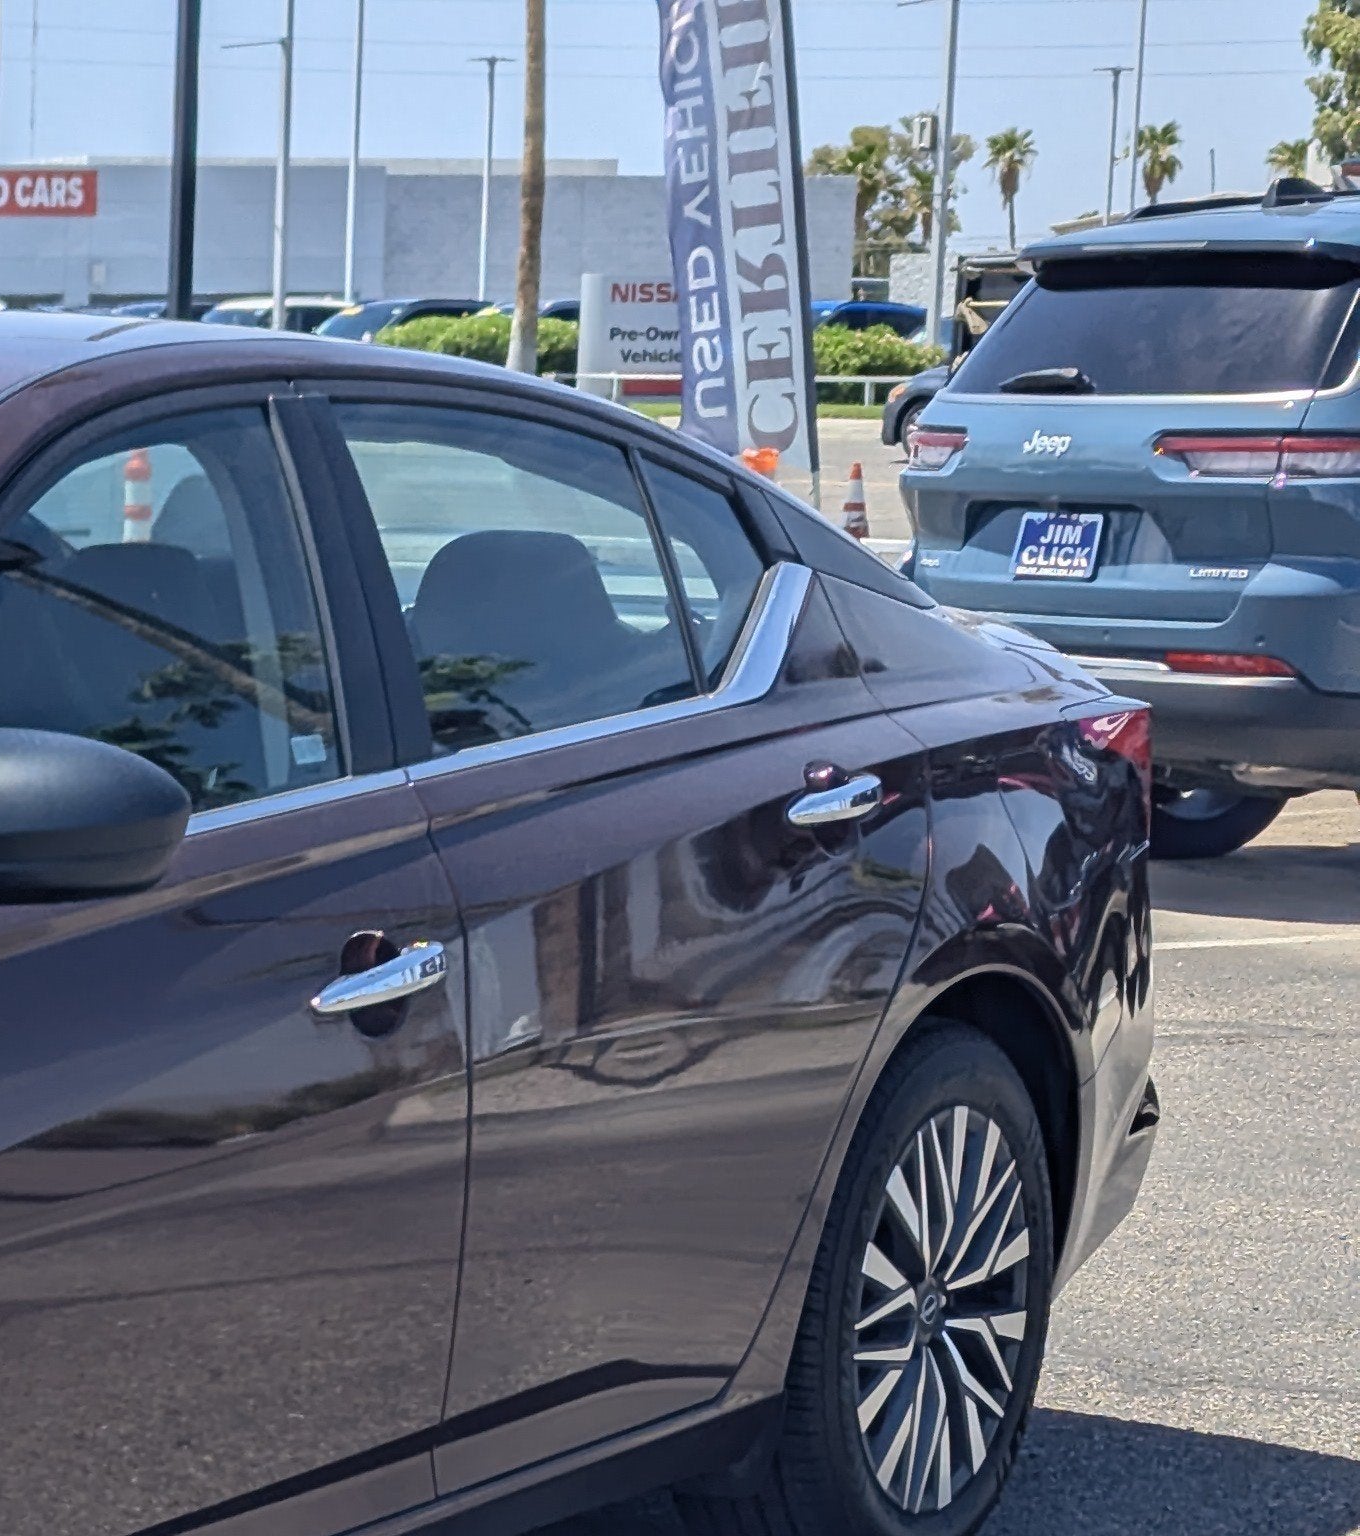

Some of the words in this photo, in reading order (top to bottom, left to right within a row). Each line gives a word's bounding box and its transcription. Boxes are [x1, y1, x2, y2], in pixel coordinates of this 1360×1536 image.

[14, 177, 84, 208] CARS
[611, 283, 678, 303] NISS
[1023, 430, 1072, 457] Jeep
[1039, 524, 1083, 544] JIM
[1021, 545, 1090, 567] CLICK
[1189, 567, 1249, 579] LIMITED
